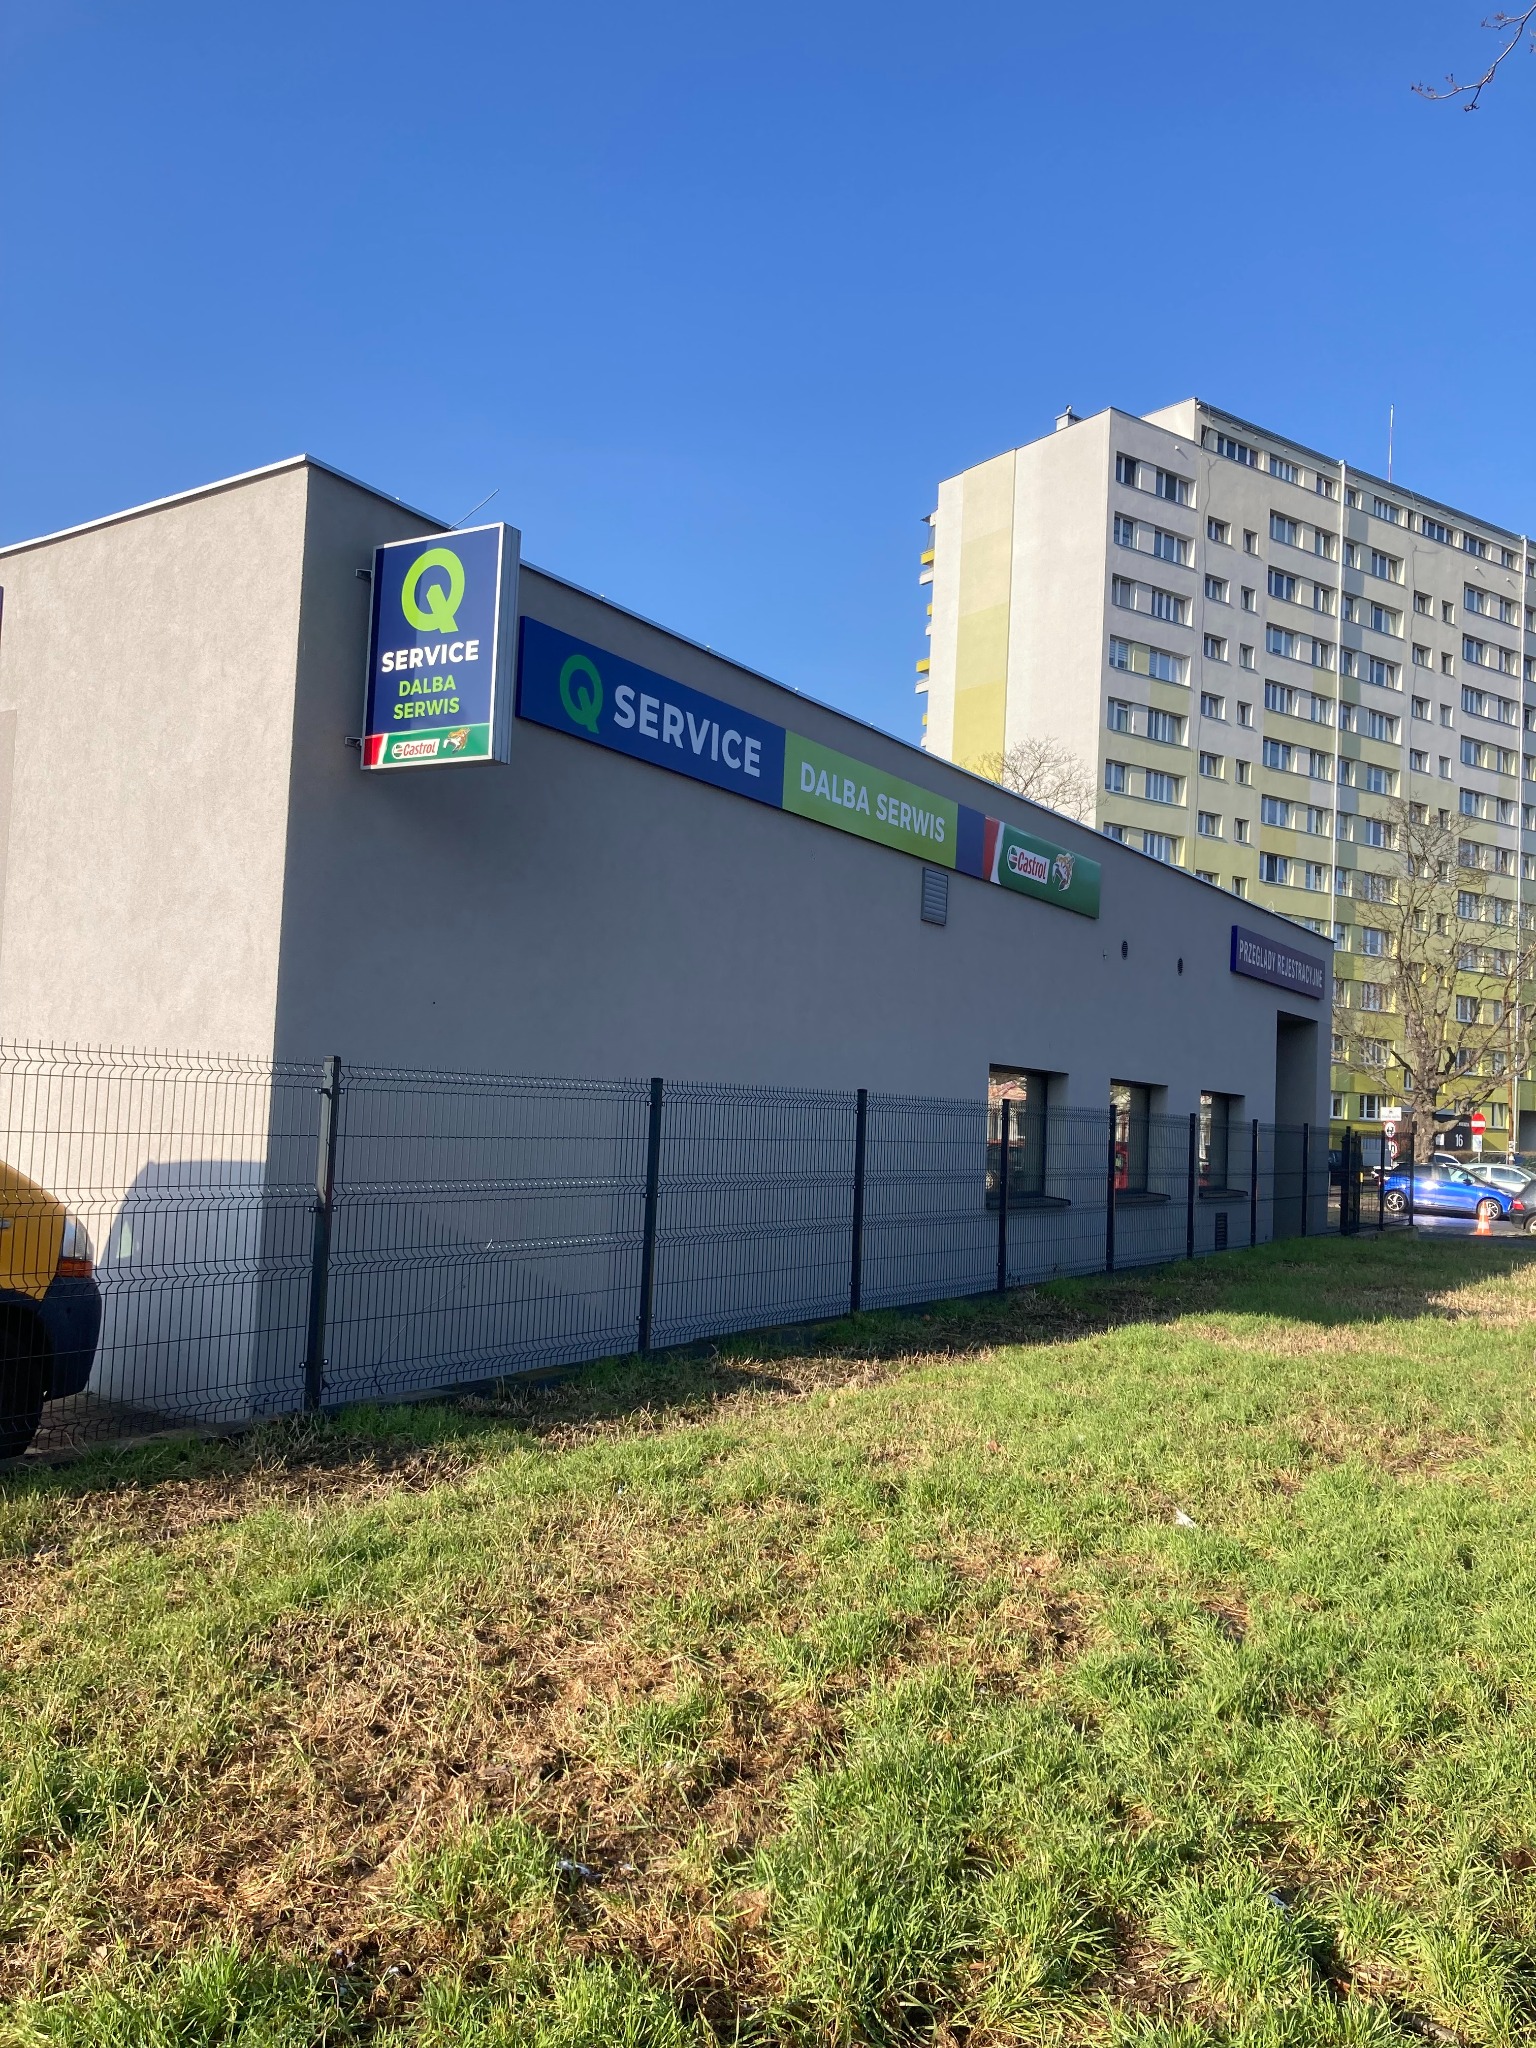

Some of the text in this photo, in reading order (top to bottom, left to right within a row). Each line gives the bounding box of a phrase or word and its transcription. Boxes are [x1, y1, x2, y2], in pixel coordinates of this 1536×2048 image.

[401, 547, 465, 633] Q
[381, 640, 479, 673] SERVICE
[398, 674, 456, 697] DALBA
[393, 697, 460, 720] SERWIS
[559, 654, 761, 777] Q SERVICE
[403, 741, 436, 756] Castrol
[800, 761, 945, 843] DALBA SERWIS
[1017, 852, 1047, 880] Castrol
[1239, 939, 1323, 988] PRZEGLĄDY REJESTRACYJNE
[1455, 1133, 1463, 1147] 16
